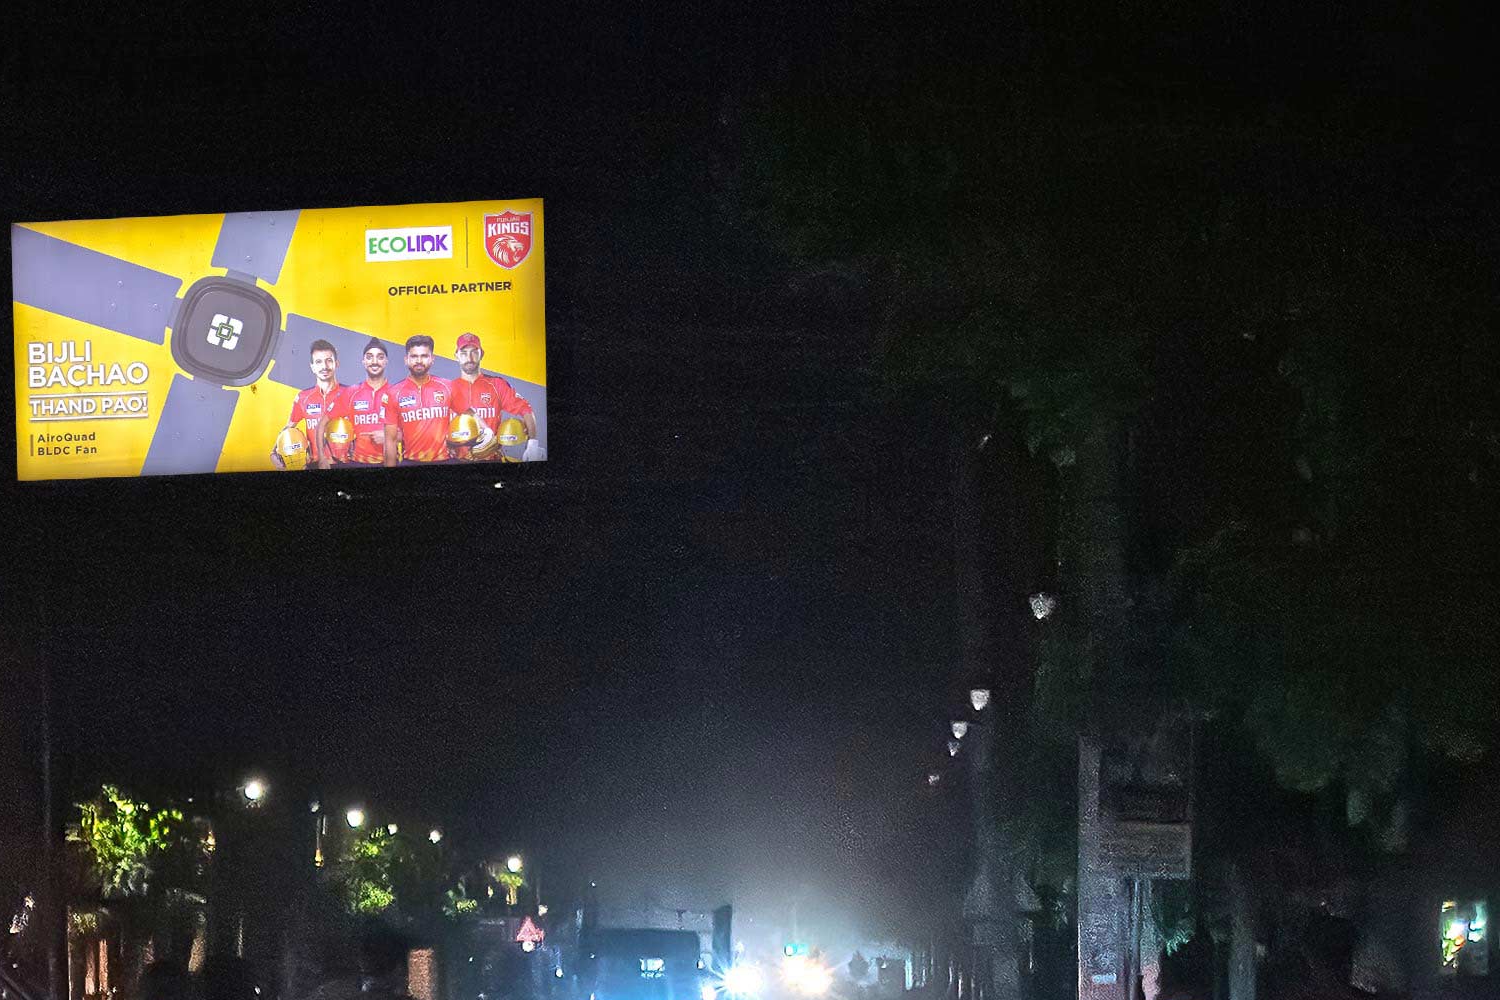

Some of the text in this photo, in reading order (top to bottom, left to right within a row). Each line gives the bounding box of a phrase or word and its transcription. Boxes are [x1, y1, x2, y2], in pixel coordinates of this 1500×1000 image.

[488, 221, 529, 237] KINGS
[368, 234, 448, 254] ECOLINK
[388, 281, 512, 297] OFFICIAL PARTNER
[28, 341, 92, 364] BIJLI
[28, 362, 149, 388] BACHAO
[29, 396, 148, 416] THAND PAO!
[37, 432, 96, 443] AiroQuad
[37, 445, 97, 456] BLDC Fan
